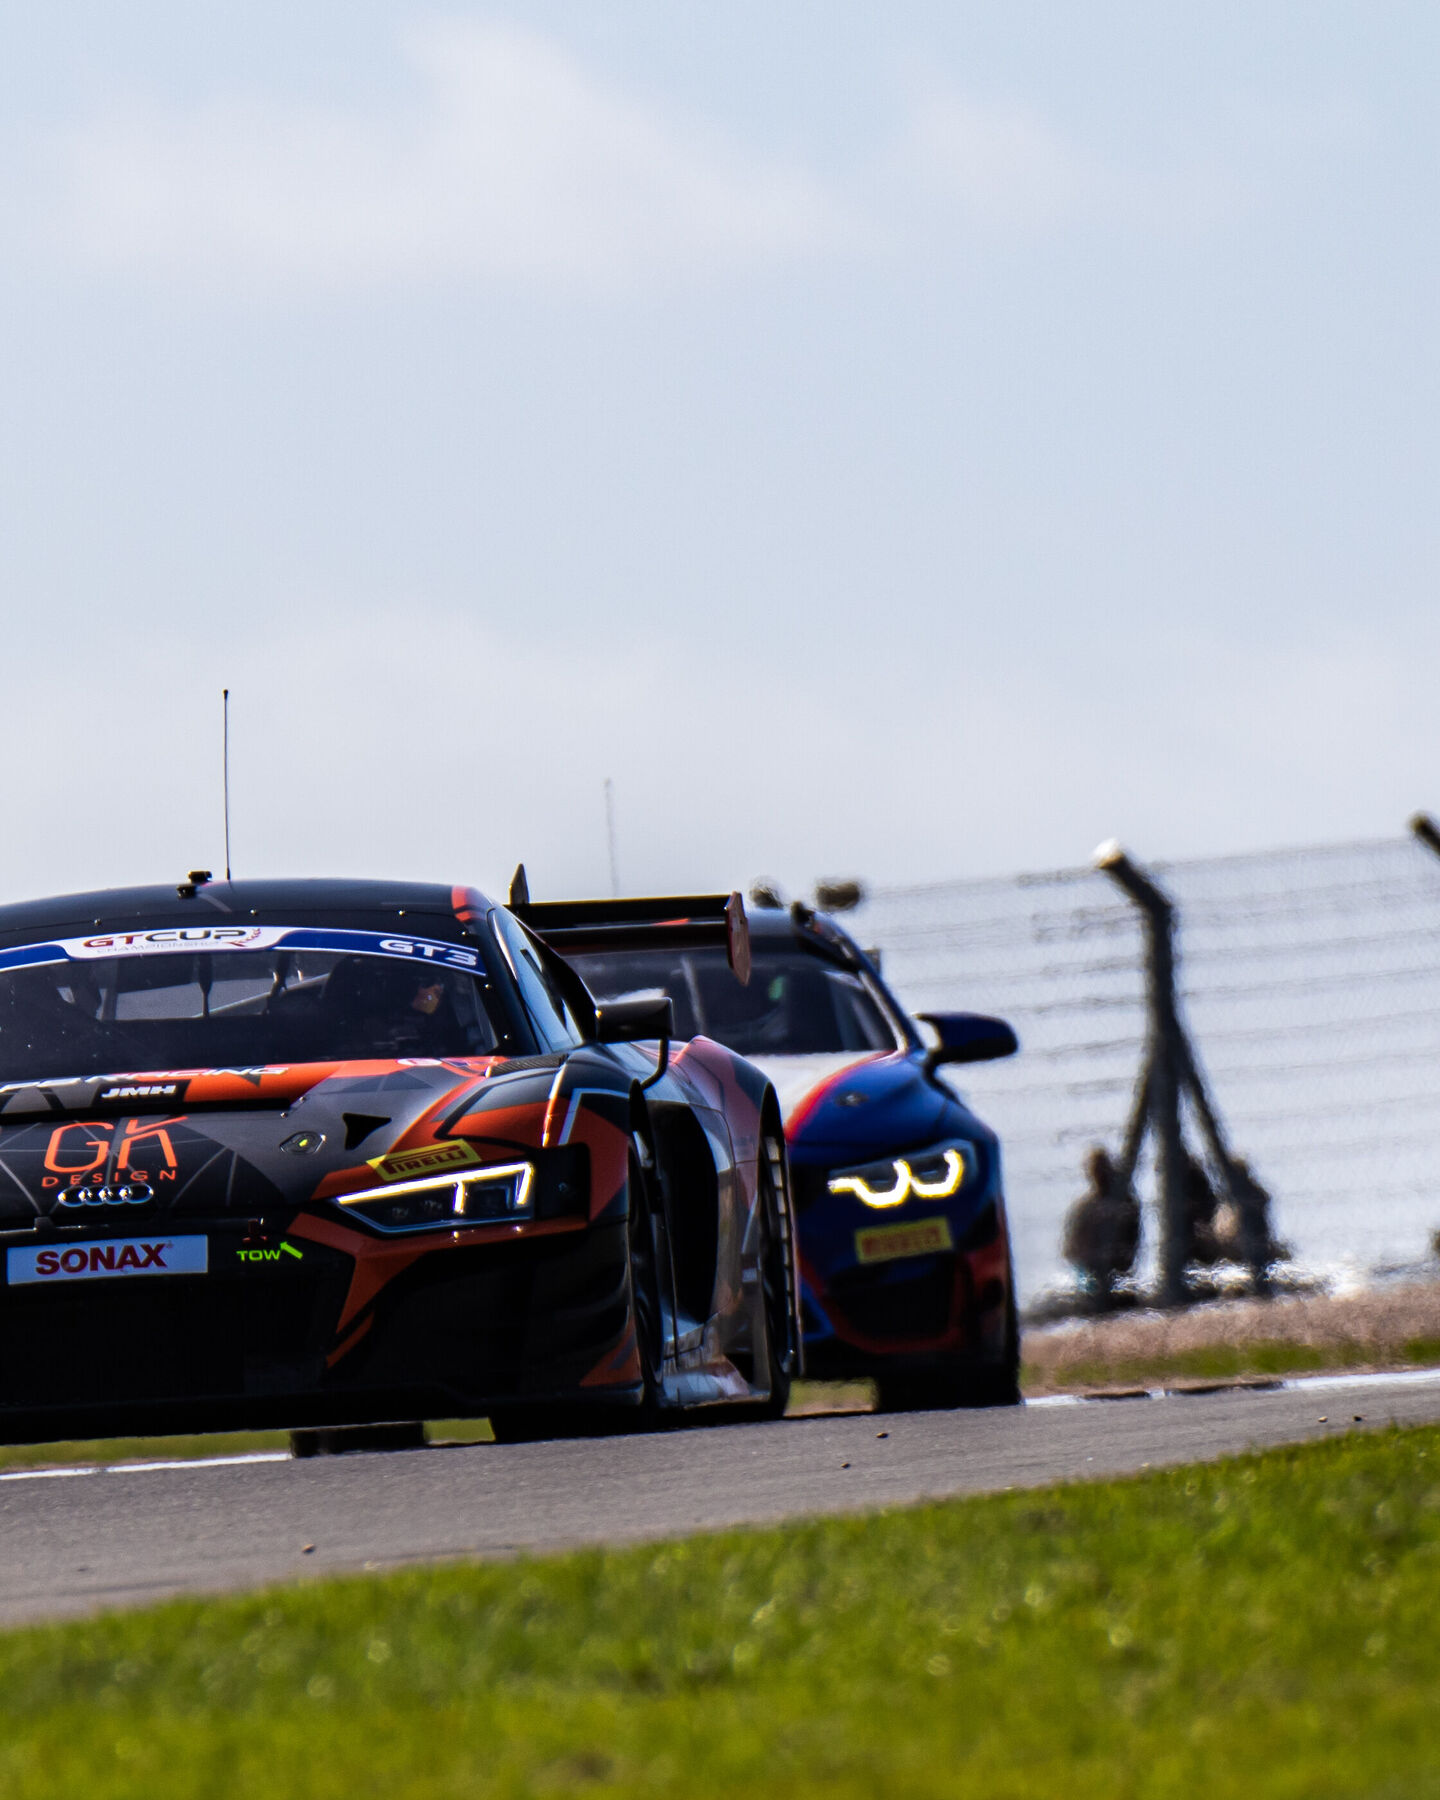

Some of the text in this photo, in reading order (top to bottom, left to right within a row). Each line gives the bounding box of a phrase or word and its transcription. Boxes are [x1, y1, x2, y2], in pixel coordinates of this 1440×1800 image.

[379, 939, 477, 966] GT3
[101, 1084, 176, 1098] JMH
[44, 1115, 189, 1173] GK
[379, 1145, 469, 1175] PIRELLI
[41, 1169, 177, 1188] DESIGN
[35, 1243, 168, 1275] SONAX
[236, 1249, 280, 1262] TOW
